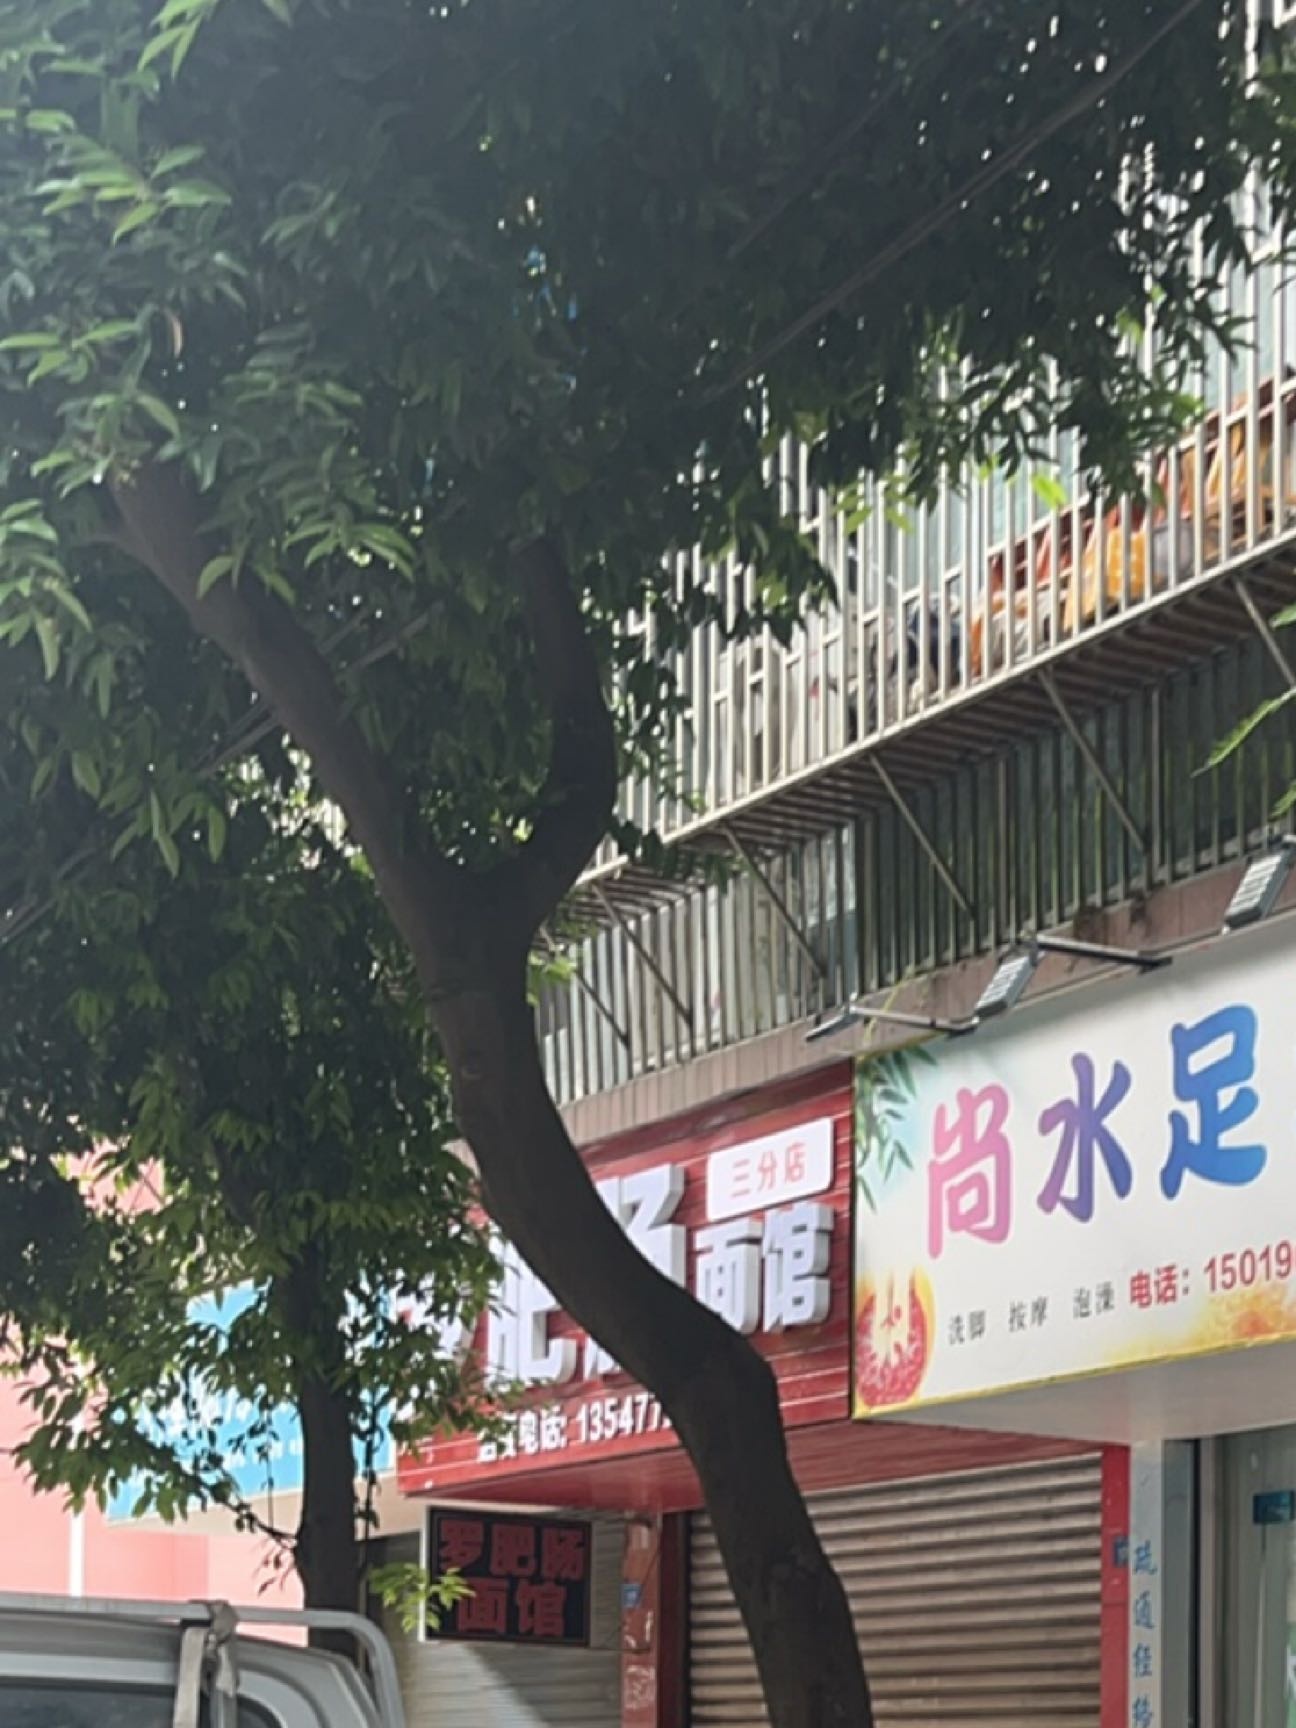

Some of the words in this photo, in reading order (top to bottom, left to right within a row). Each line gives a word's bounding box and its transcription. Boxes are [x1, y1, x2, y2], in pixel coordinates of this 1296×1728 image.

[731, 1141, 806, 1198] 三分店
[695, 1202, 836, 1336] 面馆
[947, 1310, 987, 1346] 洗脚
[1008, 1296, 1049, 1332] 按摩
